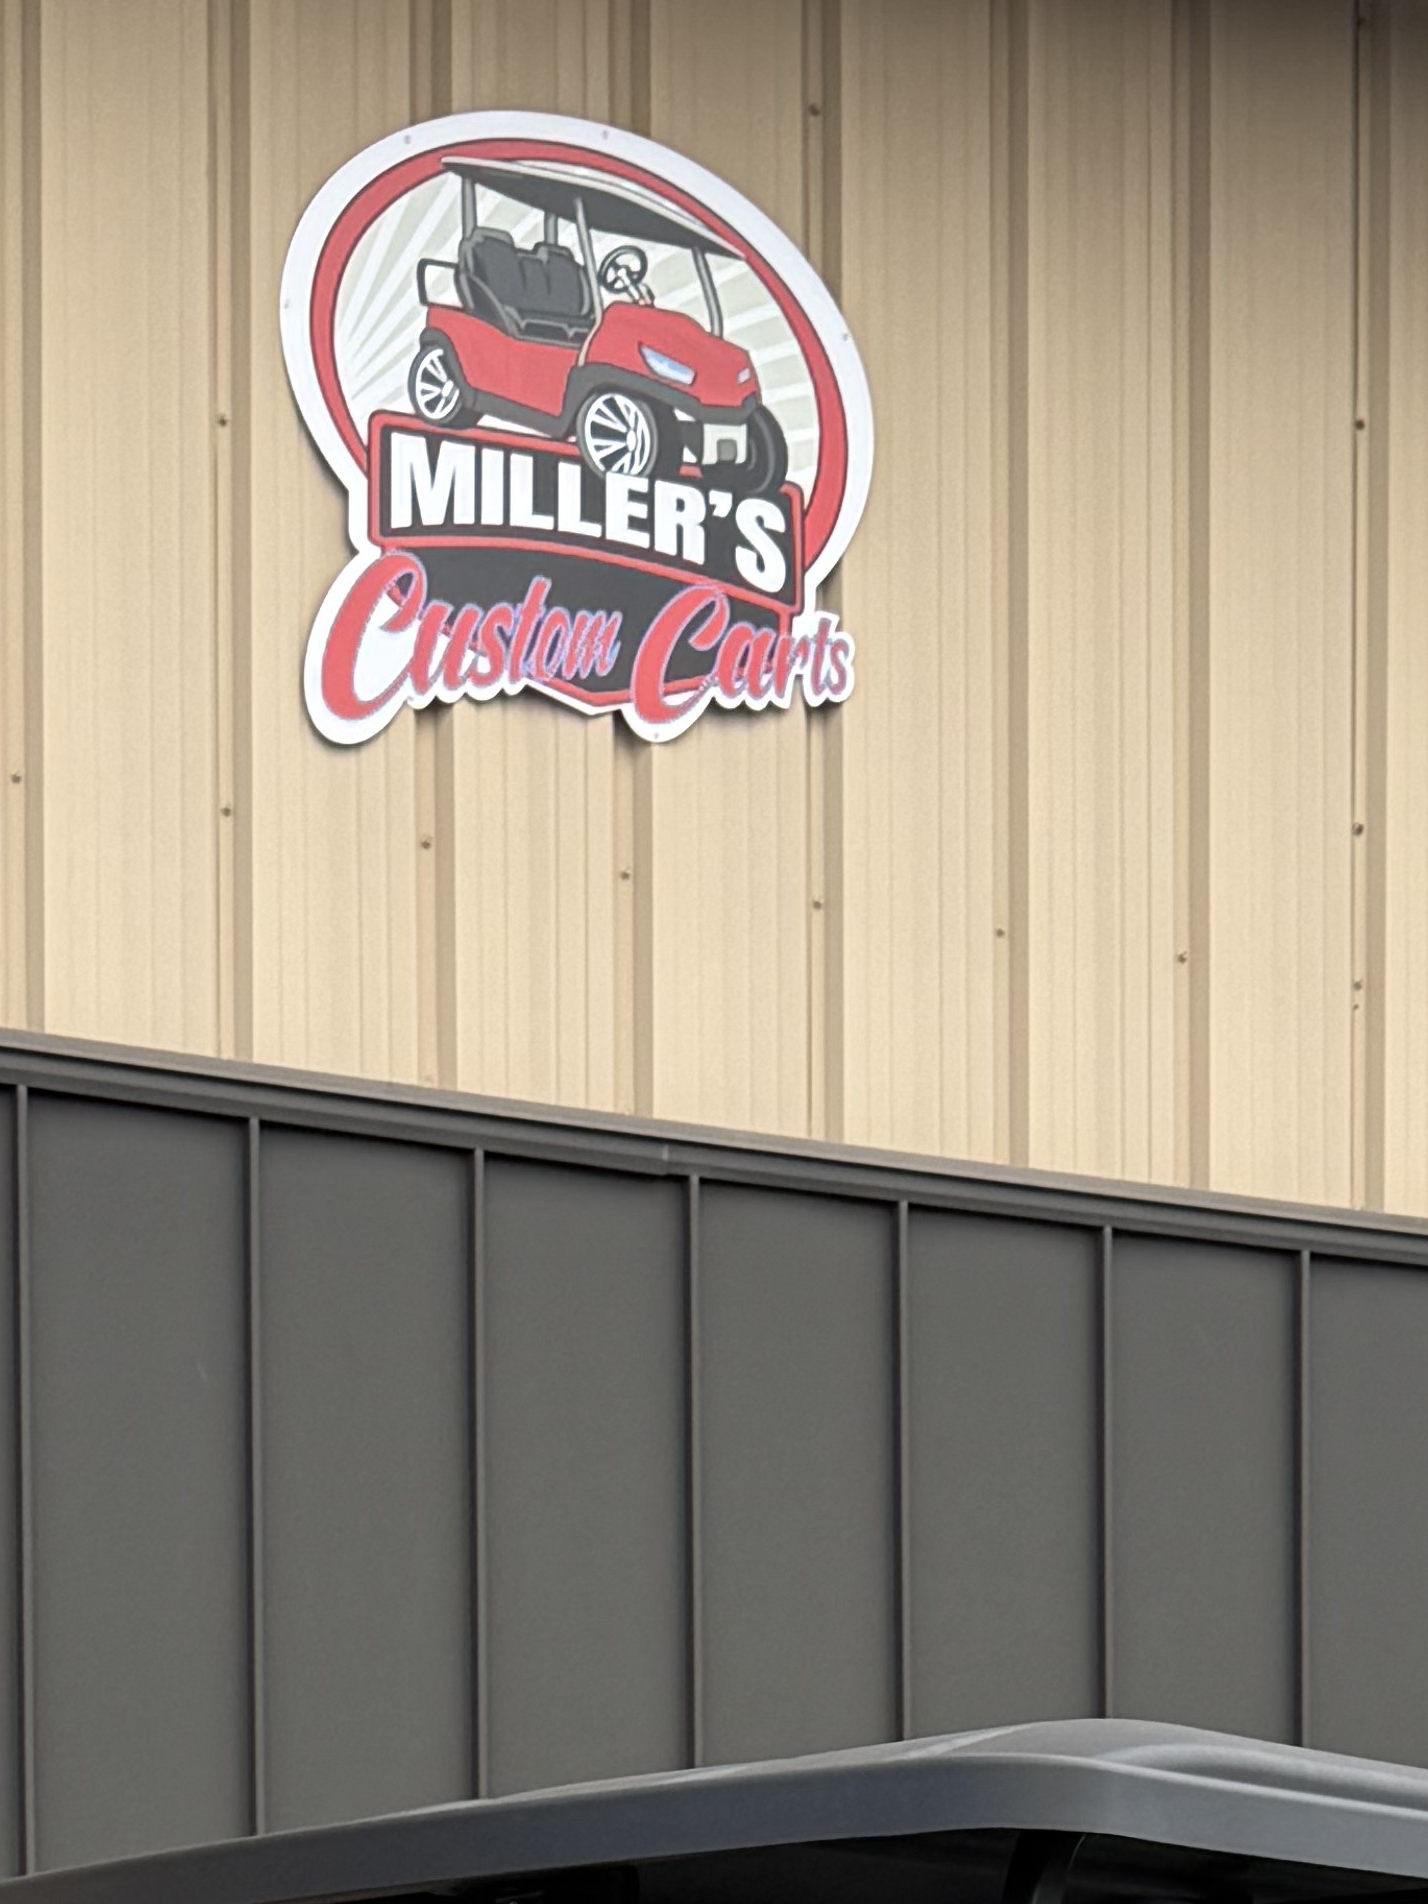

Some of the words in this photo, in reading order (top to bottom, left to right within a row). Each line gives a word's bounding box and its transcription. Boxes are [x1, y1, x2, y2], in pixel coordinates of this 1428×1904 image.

[389, 431, 787, 594] MILLER'S
[321, 550, 621, 722] Custom
[630, 584, 850, 723] Carts
